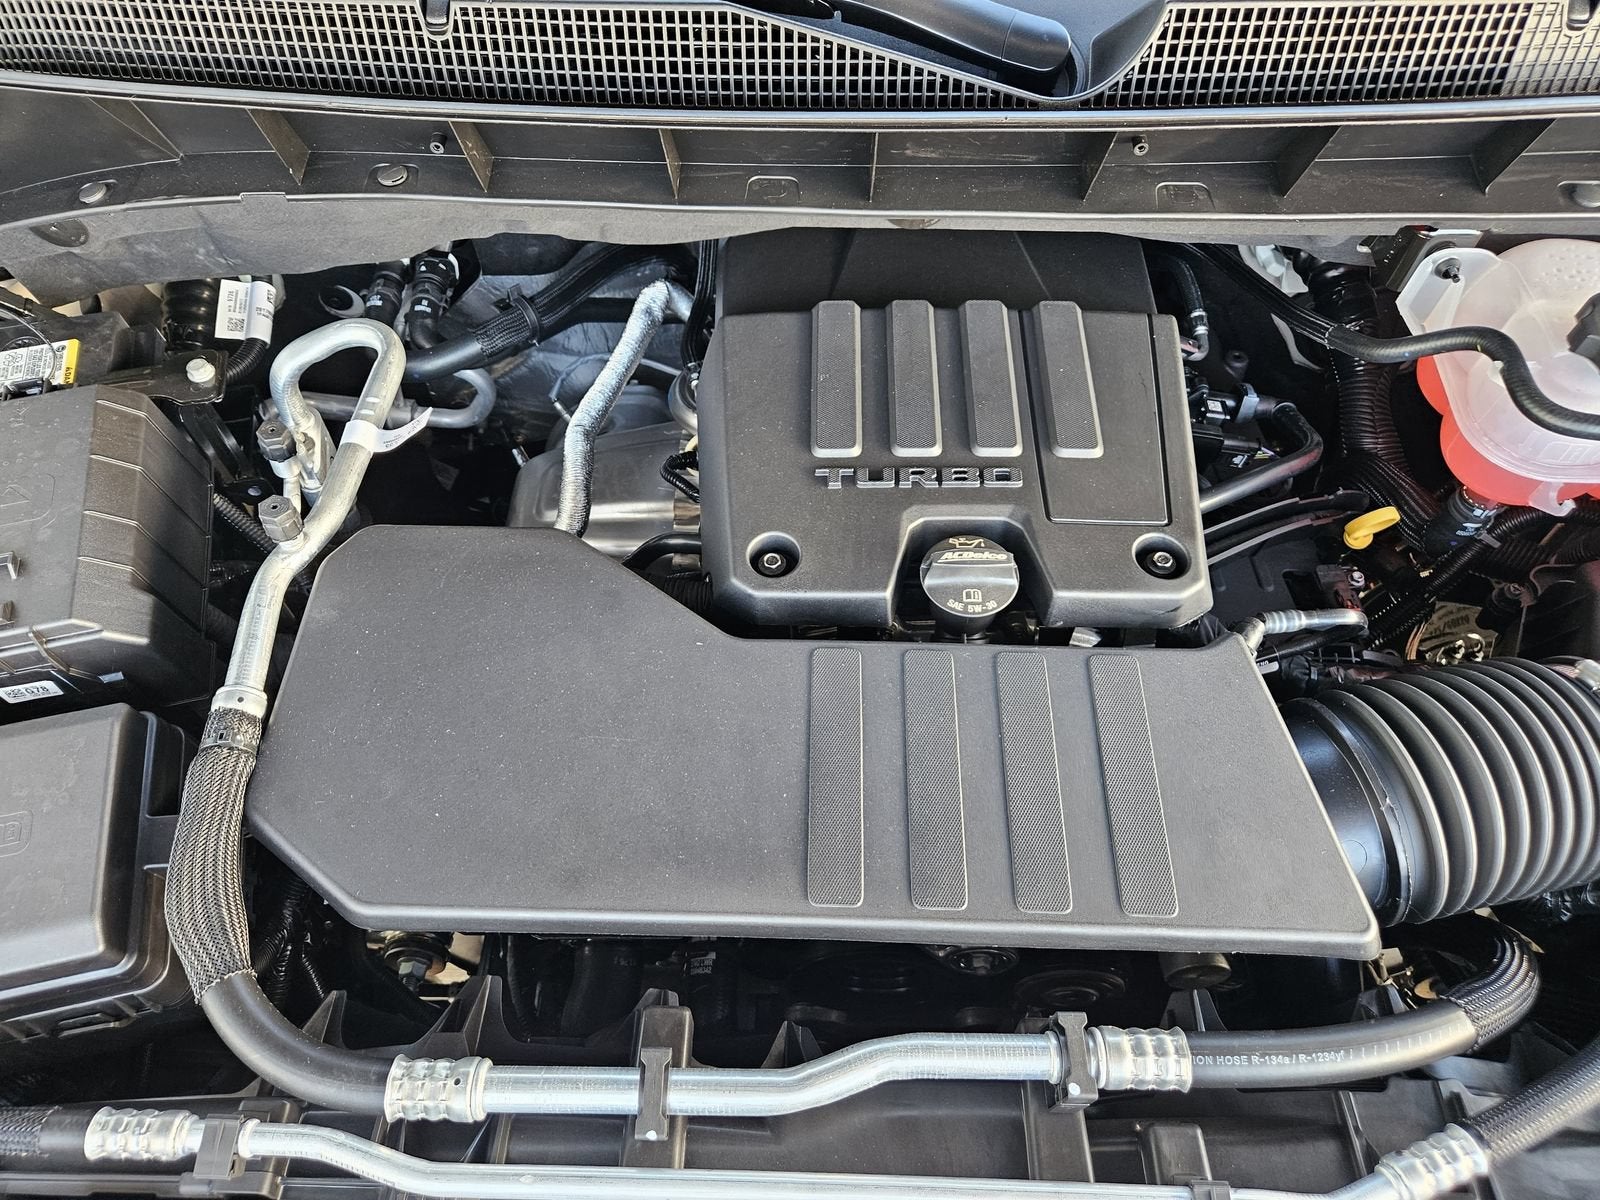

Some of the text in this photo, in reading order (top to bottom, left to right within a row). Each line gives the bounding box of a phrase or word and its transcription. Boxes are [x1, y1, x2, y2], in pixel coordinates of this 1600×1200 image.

[814, 467, 1023, 489] TURBO
[940, 551, 1008, 560] ACDelco
[946, 599, 998, 613] SAE 5W-30
[1216, 1055, 1249, 1065] HOSE
[1251, 1054, 1290, 1065] R-134a
[1298, 1050, 1345, 1063] R-1234yf
